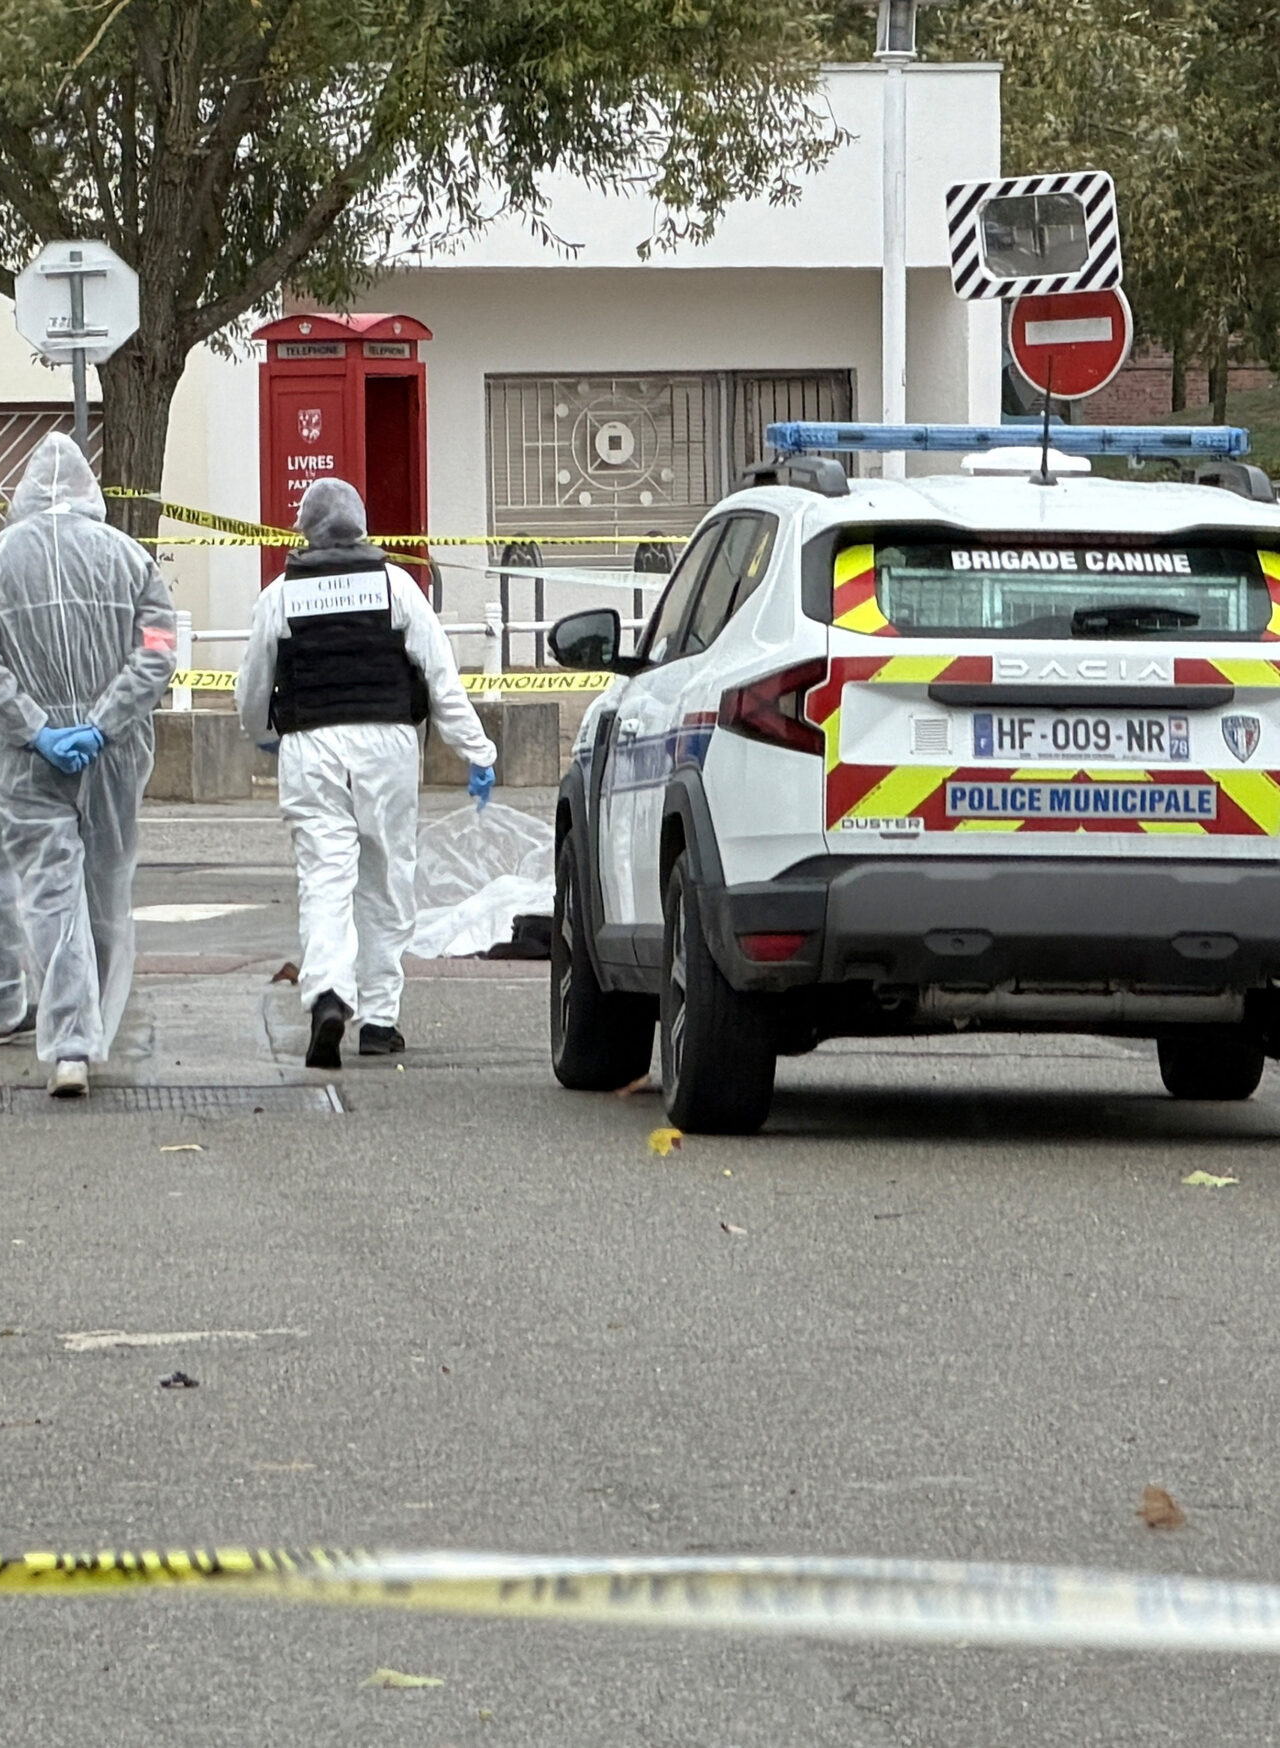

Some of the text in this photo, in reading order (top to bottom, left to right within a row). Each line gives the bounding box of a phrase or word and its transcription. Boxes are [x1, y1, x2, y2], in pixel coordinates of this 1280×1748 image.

[287, 454, 334, 470] LIVRES
[951, 550, 1192, 574] BRIGADE CANINE
[997, 657, 1170, 680] DACIA
[950, 786, 1212, 814] POLICE MUNICIPALE
[841, 818, 921, 829] DUSTER
